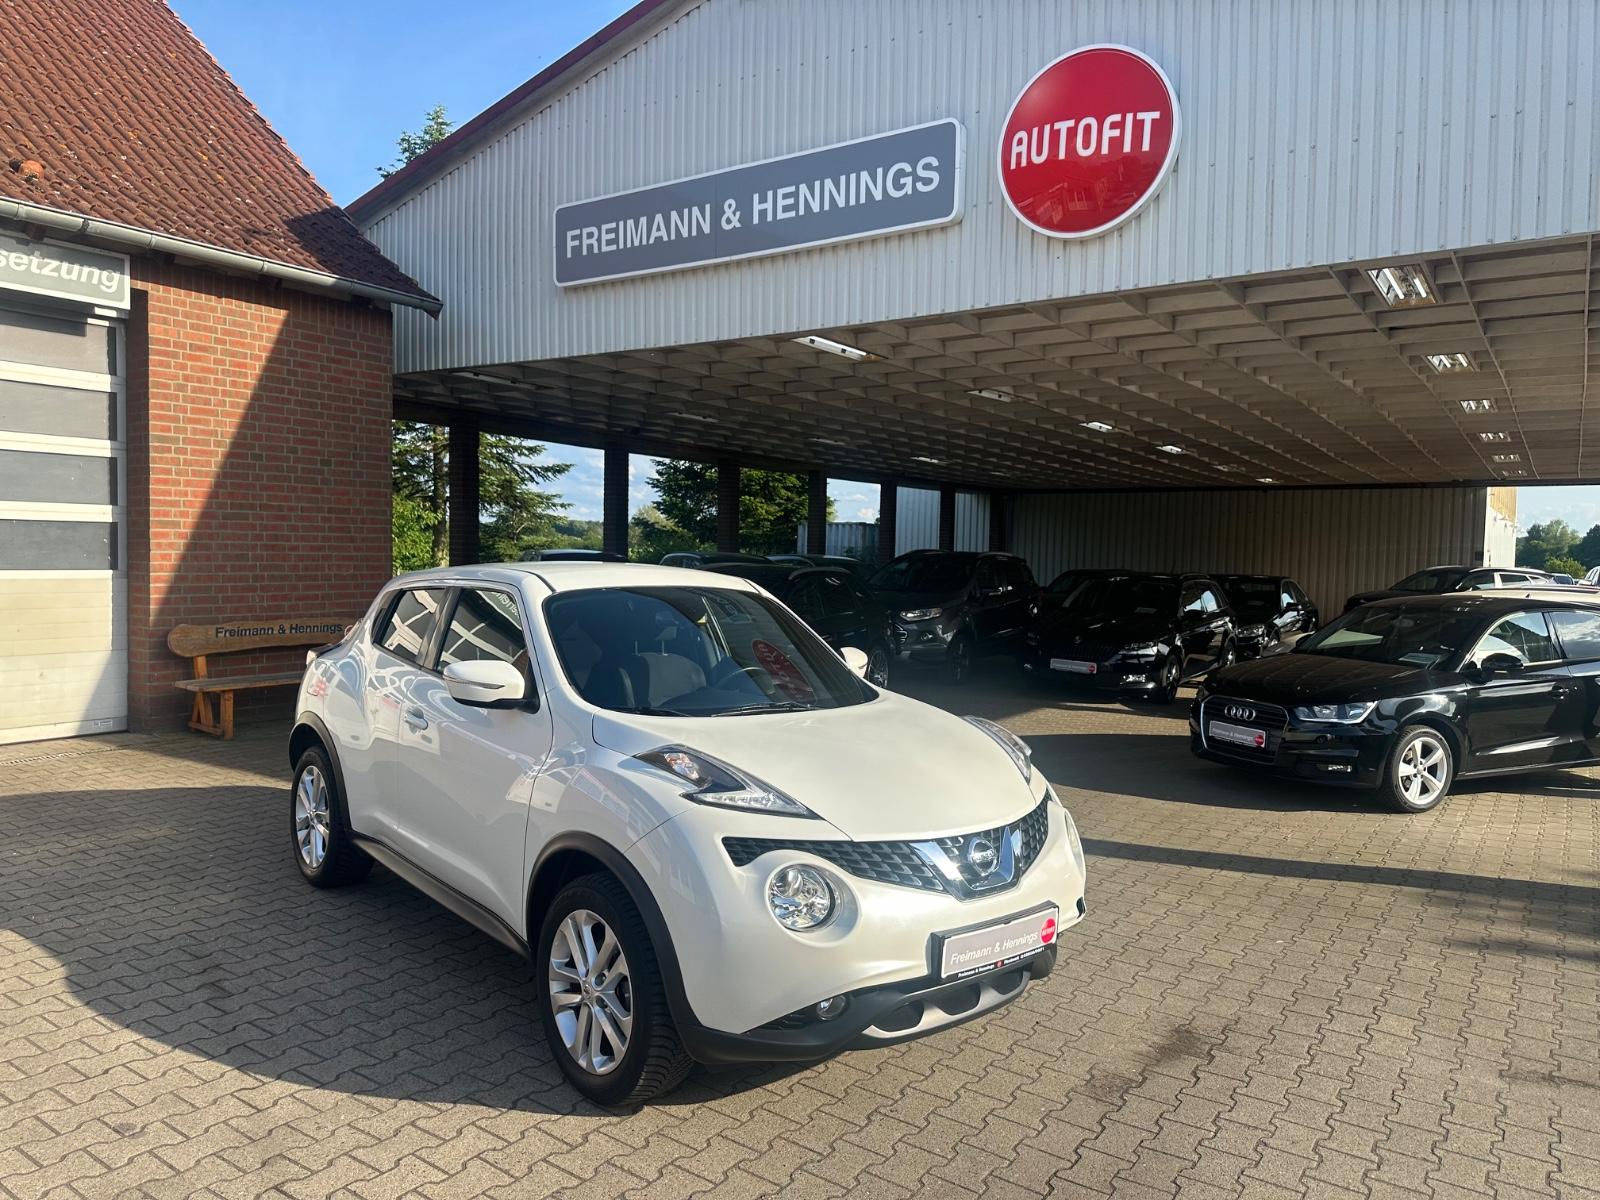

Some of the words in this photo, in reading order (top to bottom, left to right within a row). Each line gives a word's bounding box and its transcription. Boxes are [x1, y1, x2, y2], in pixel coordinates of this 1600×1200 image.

[1010, 111, 1161, 170] AUTOFIT
[566, 203, 711, 259] FREIMANN
[720, 198, 742, 231] &
[752, 156, 940, 226] HENNINGS
[215, 626, 274, 639] Freimann
[277, 623, 286, 635] &
[289, 623, 344, 635] Hennings
[950, 946, 992, 965] Freimann
[994, 941, 1001, 953] &
[1002, 930, 1039, 950] Hennings
